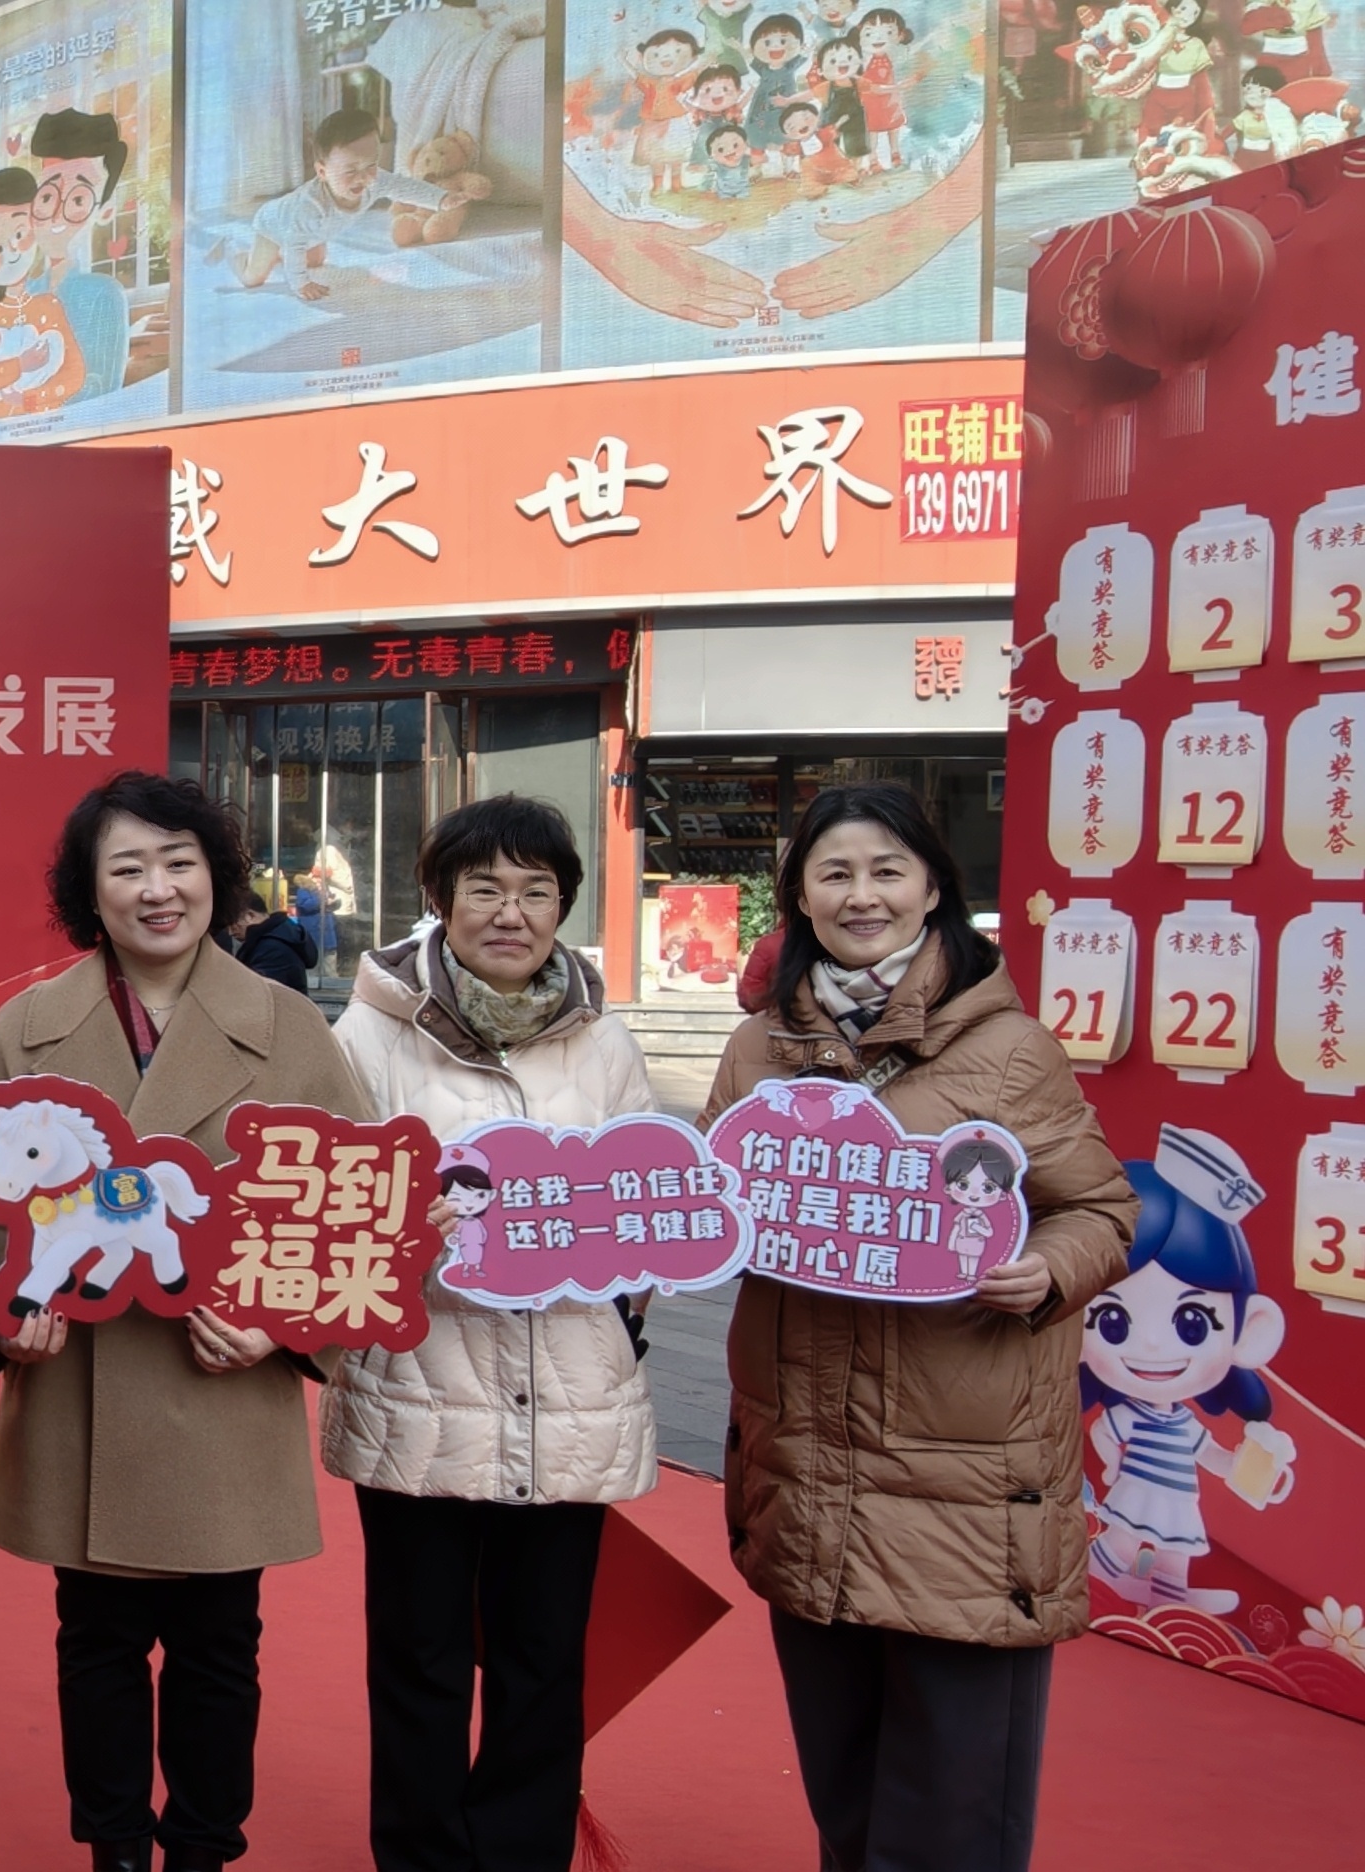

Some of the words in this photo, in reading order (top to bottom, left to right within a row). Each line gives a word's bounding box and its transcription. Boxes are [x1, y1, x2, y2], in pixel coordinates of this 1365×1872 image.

[1263, 330, 1361, 426] 健
[904, 470, 947, 536] 139
[952, 469, 1009, 534] 6971
[1182, 536, 1262, 567] 有奖竞答
[1089, 545, 1117, 671] 有奖竞答
[1200, 597, 1234, 652] 2
[1324, 584, 1363, 641] 3
[1176, 733, 1256, 757] 有奖竞答
[1080, 731, 1107, 855] 有奖竞答
[1324, 716, 1356, 855] 有奖竞答
[1175, 790, 1246, 845] 12
[1052, 930, 1123, 955] 有奖竞答
[1167, 930, 1248, 957] 有奖竞答
[1052, 988, 1106, 1042] 21
[1166, 990, 1237, 1049] 22
[1316, 926, 1347, 1070] 有奖竞答
[237, 1125, 412, 1236] 马到
[500, 1163, 723, 1211] 给我一份信任
[739, 1129, 934, 1193] 你的健康
[505, 1206, 726, 1252] 还你一身健康
[747, 1178, 942, 1246] 就是我们
[216, 1219, 404, 1330] 福来
[756, 1234, 901, 1288] 的心愿
